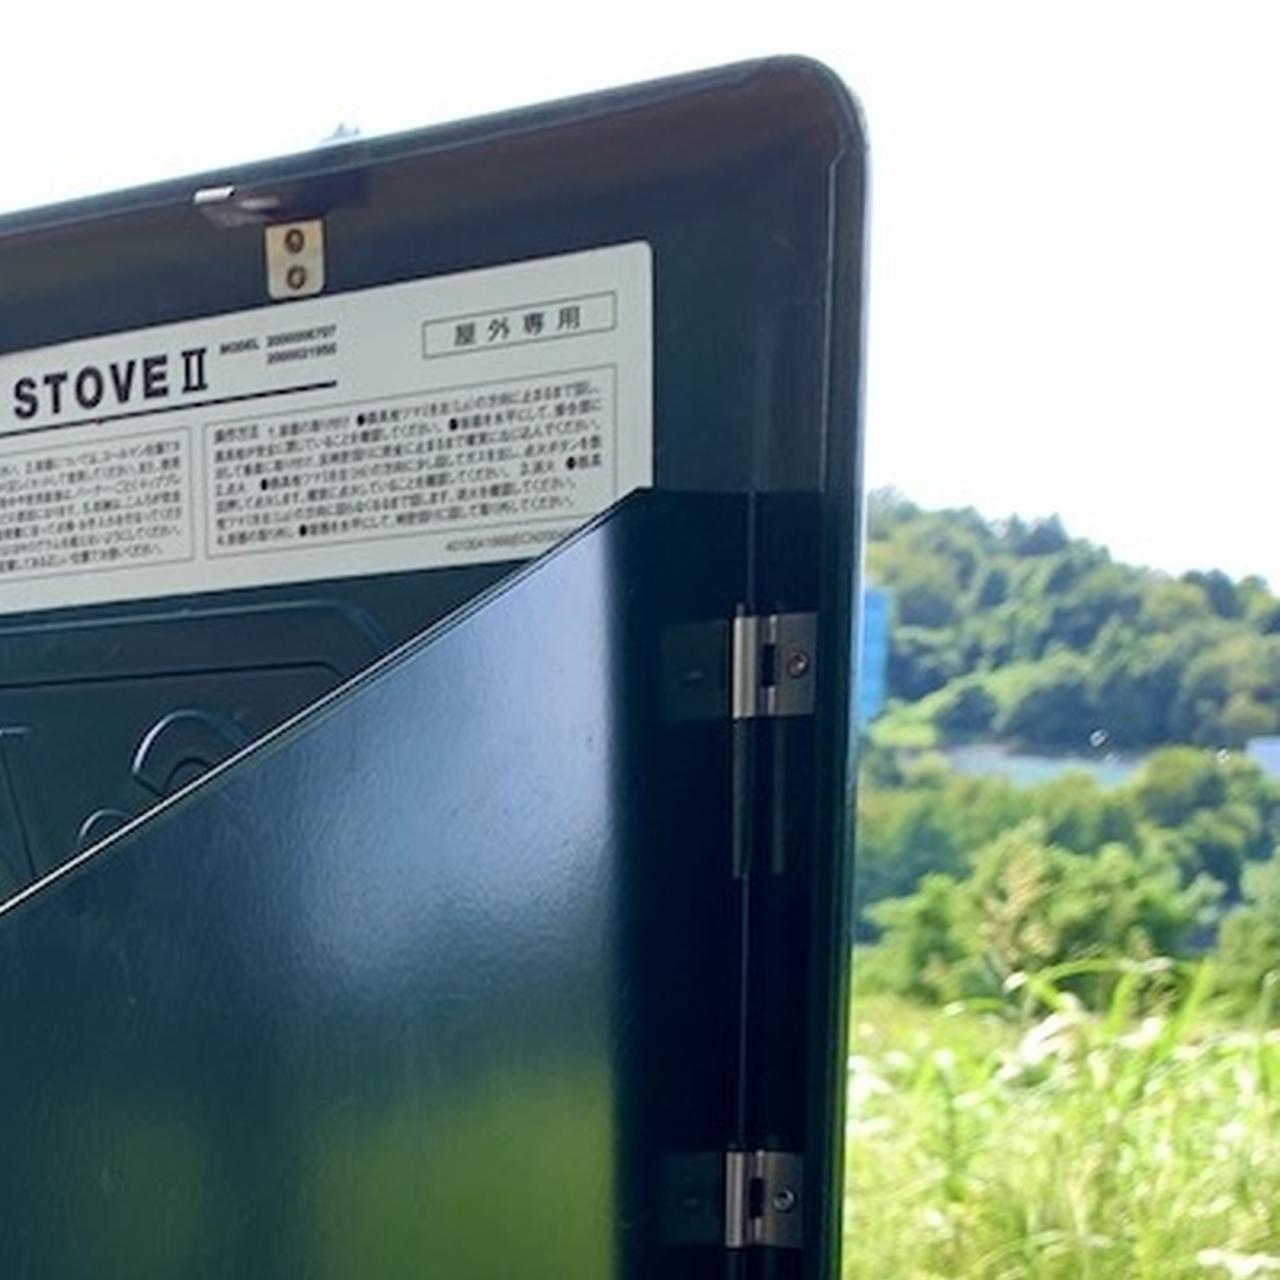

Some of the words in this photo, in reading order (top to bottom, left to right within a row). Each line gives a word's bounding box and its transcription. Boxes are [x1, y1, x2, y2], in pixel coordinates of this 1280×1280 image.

[454, 305, 582, 347] 屋外専用
[14, 354, 170, 419] STOVE
